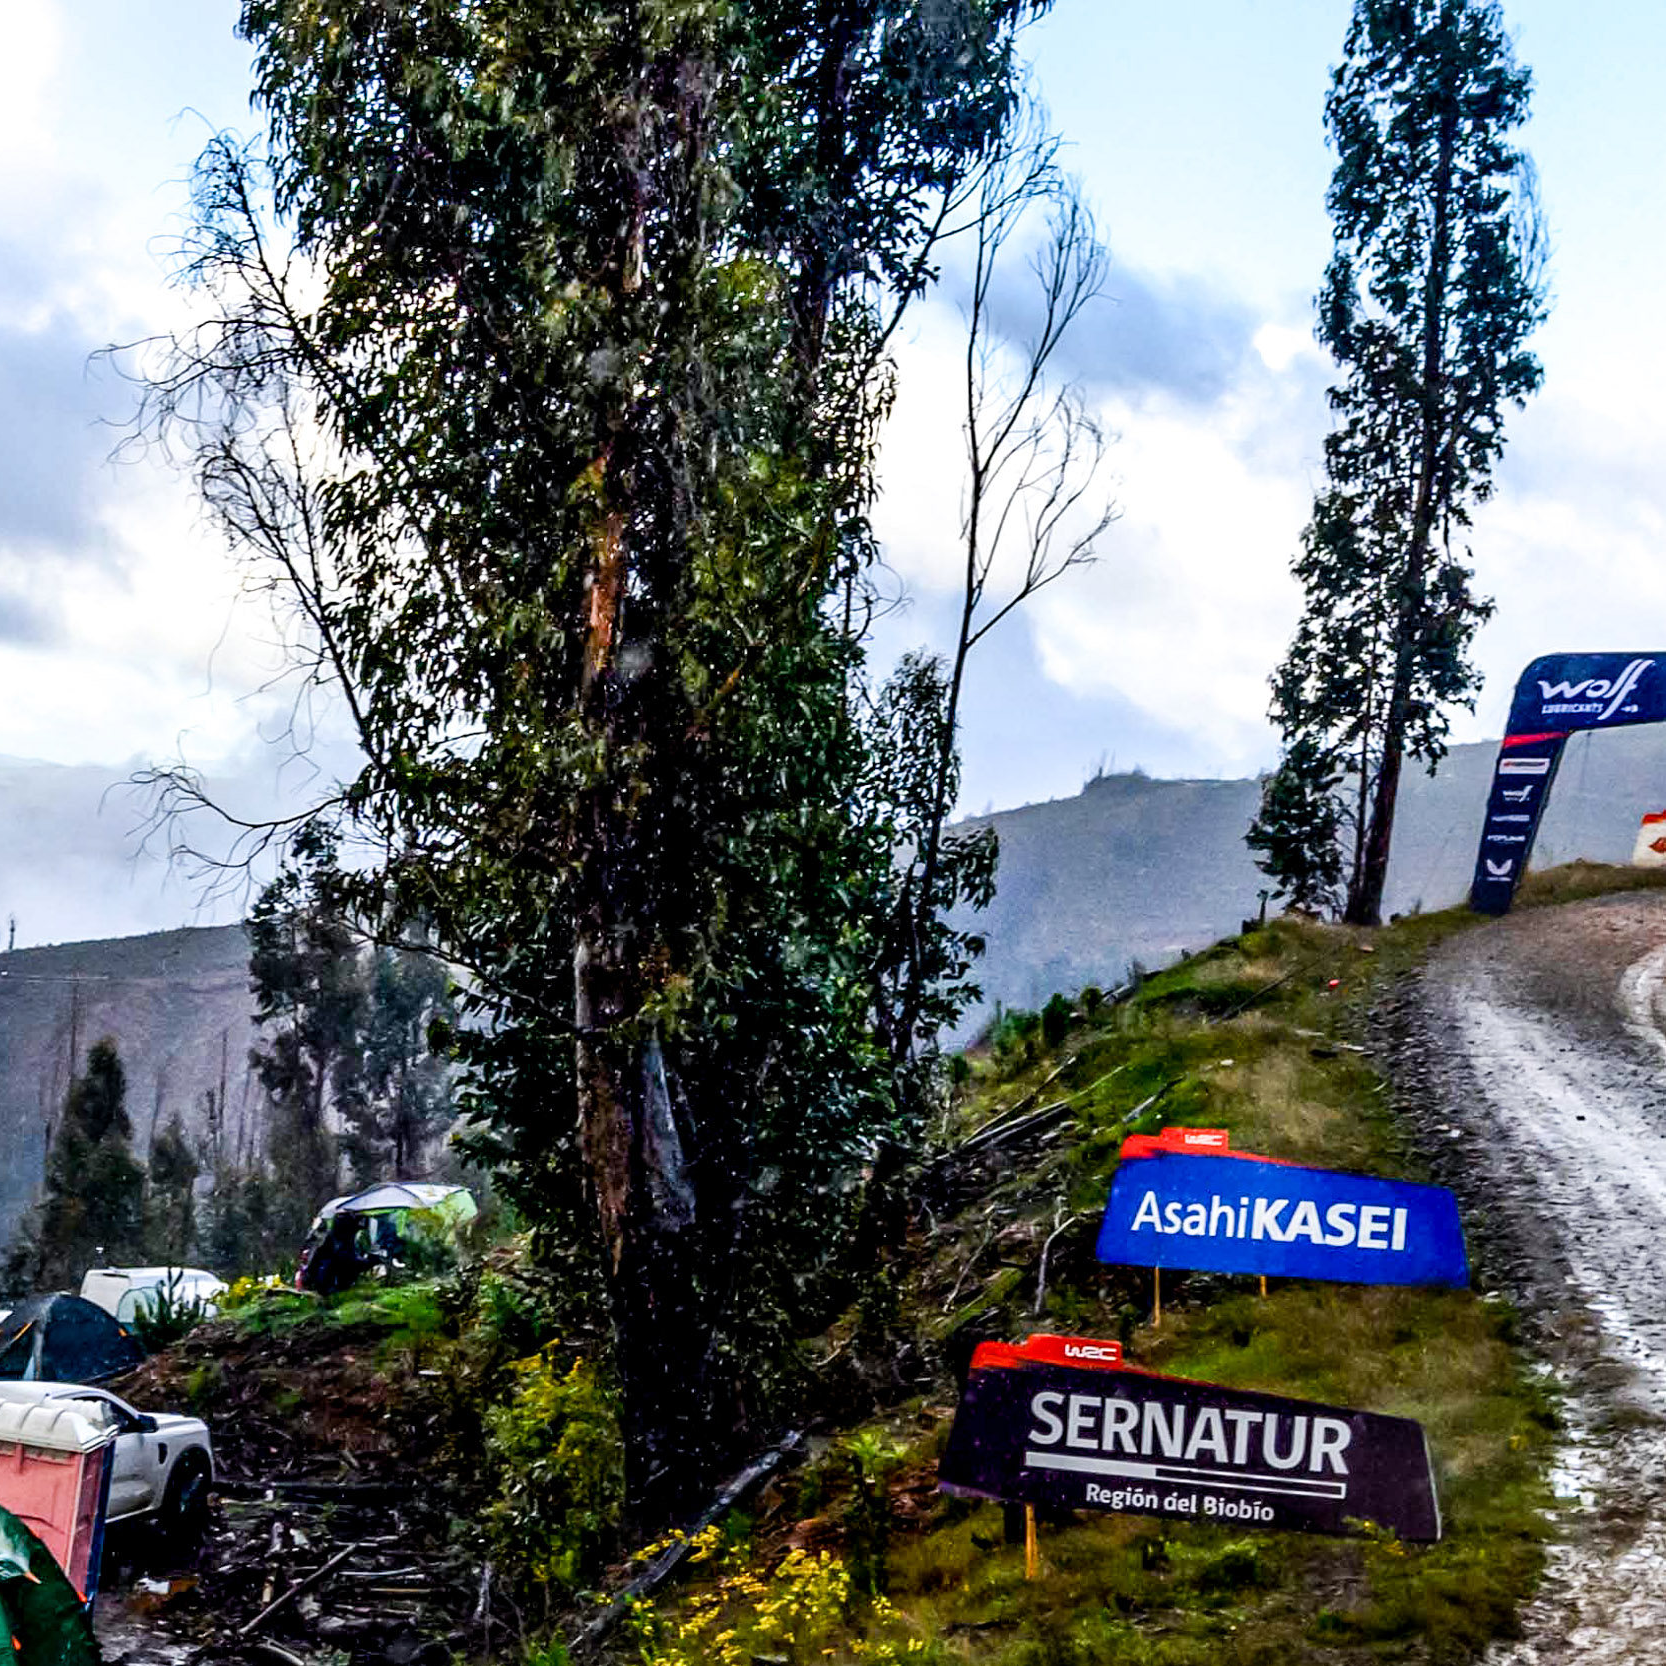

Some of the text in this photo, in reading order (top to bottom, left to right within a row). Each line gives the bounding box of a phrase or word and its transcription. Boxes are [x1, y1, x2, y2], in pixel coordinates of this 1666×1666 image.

[1131, 1190, 1407, 1251] AsahiKASEI
[1065, 1344, 1117, 1361] WRC
[1028, 1391, 1352, 1475] SERNATUR
[1085, 1483, 1275, 1521] Región del Biobío
